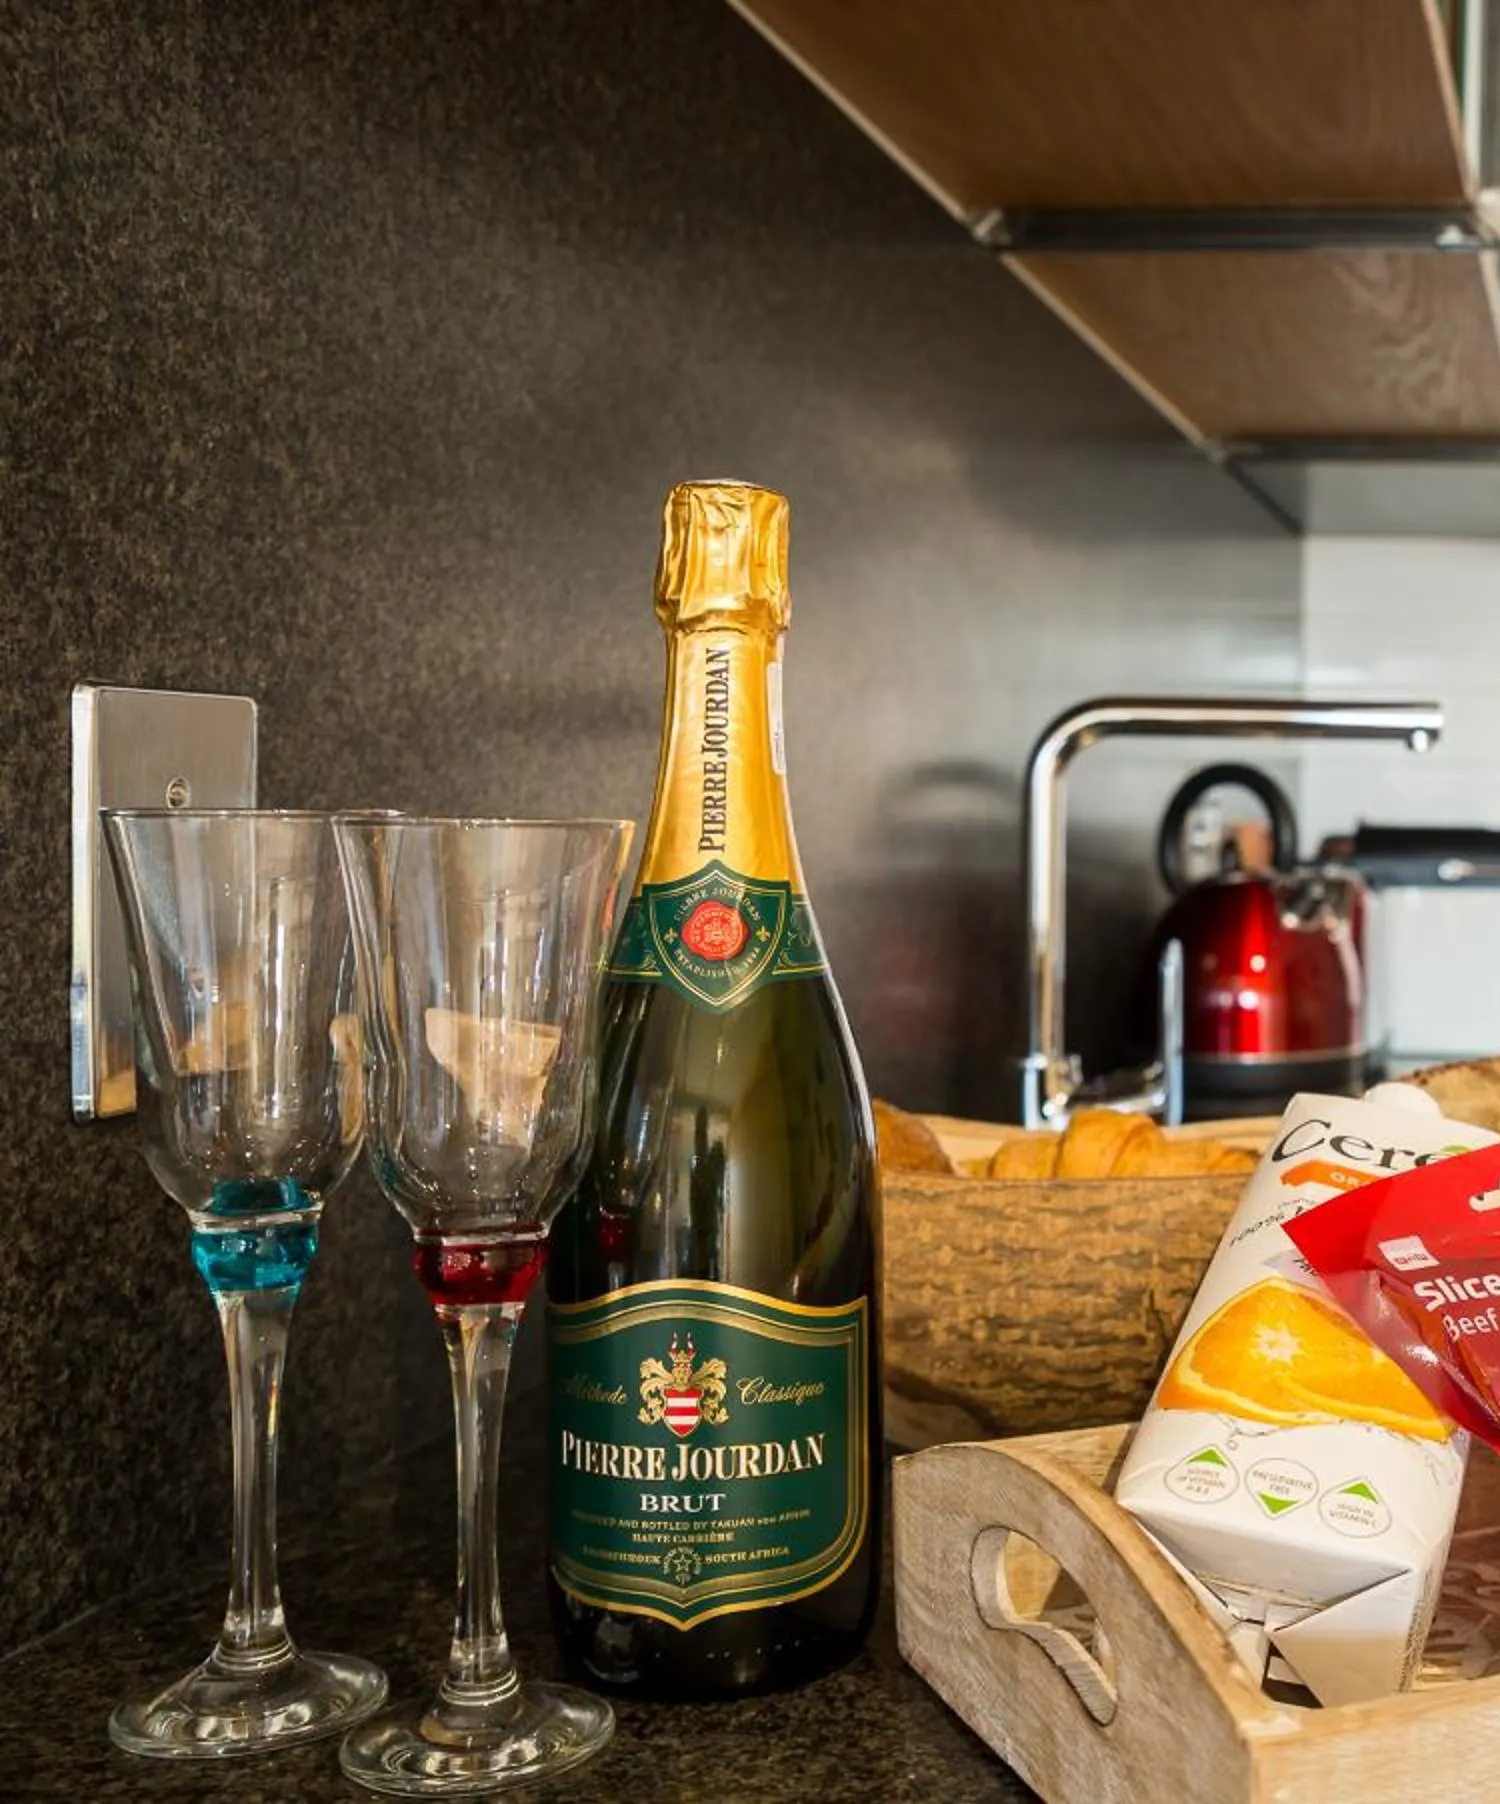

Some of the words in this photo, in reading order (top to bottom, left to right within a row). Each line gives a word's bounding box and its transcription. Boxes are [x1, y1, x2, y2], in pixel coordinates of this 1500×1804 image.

[700, 648, 731, 760] JOURDAN
[698, 761, 728, 854] PIERRE
[1444, 1307, 1499, 1342] Beef
[735, 1375, 827, 1406] Classique
[561, 1429, 666, 1481] PIERRE
[671, 1432, 827, 1483] JOURDAN
[639, 1492, 727, 1513] BRUT
[618, 1518, 640, 1529] AND
[641, 1520, 690, 1531] BOTTLED
[693, 1520, 708, 1531] BY
[632, 1532, 671, 1543] HAUTE
[704, 1551, 747, 1564] SOUTH
[748, 1546, 791, 1560] AFRICA
